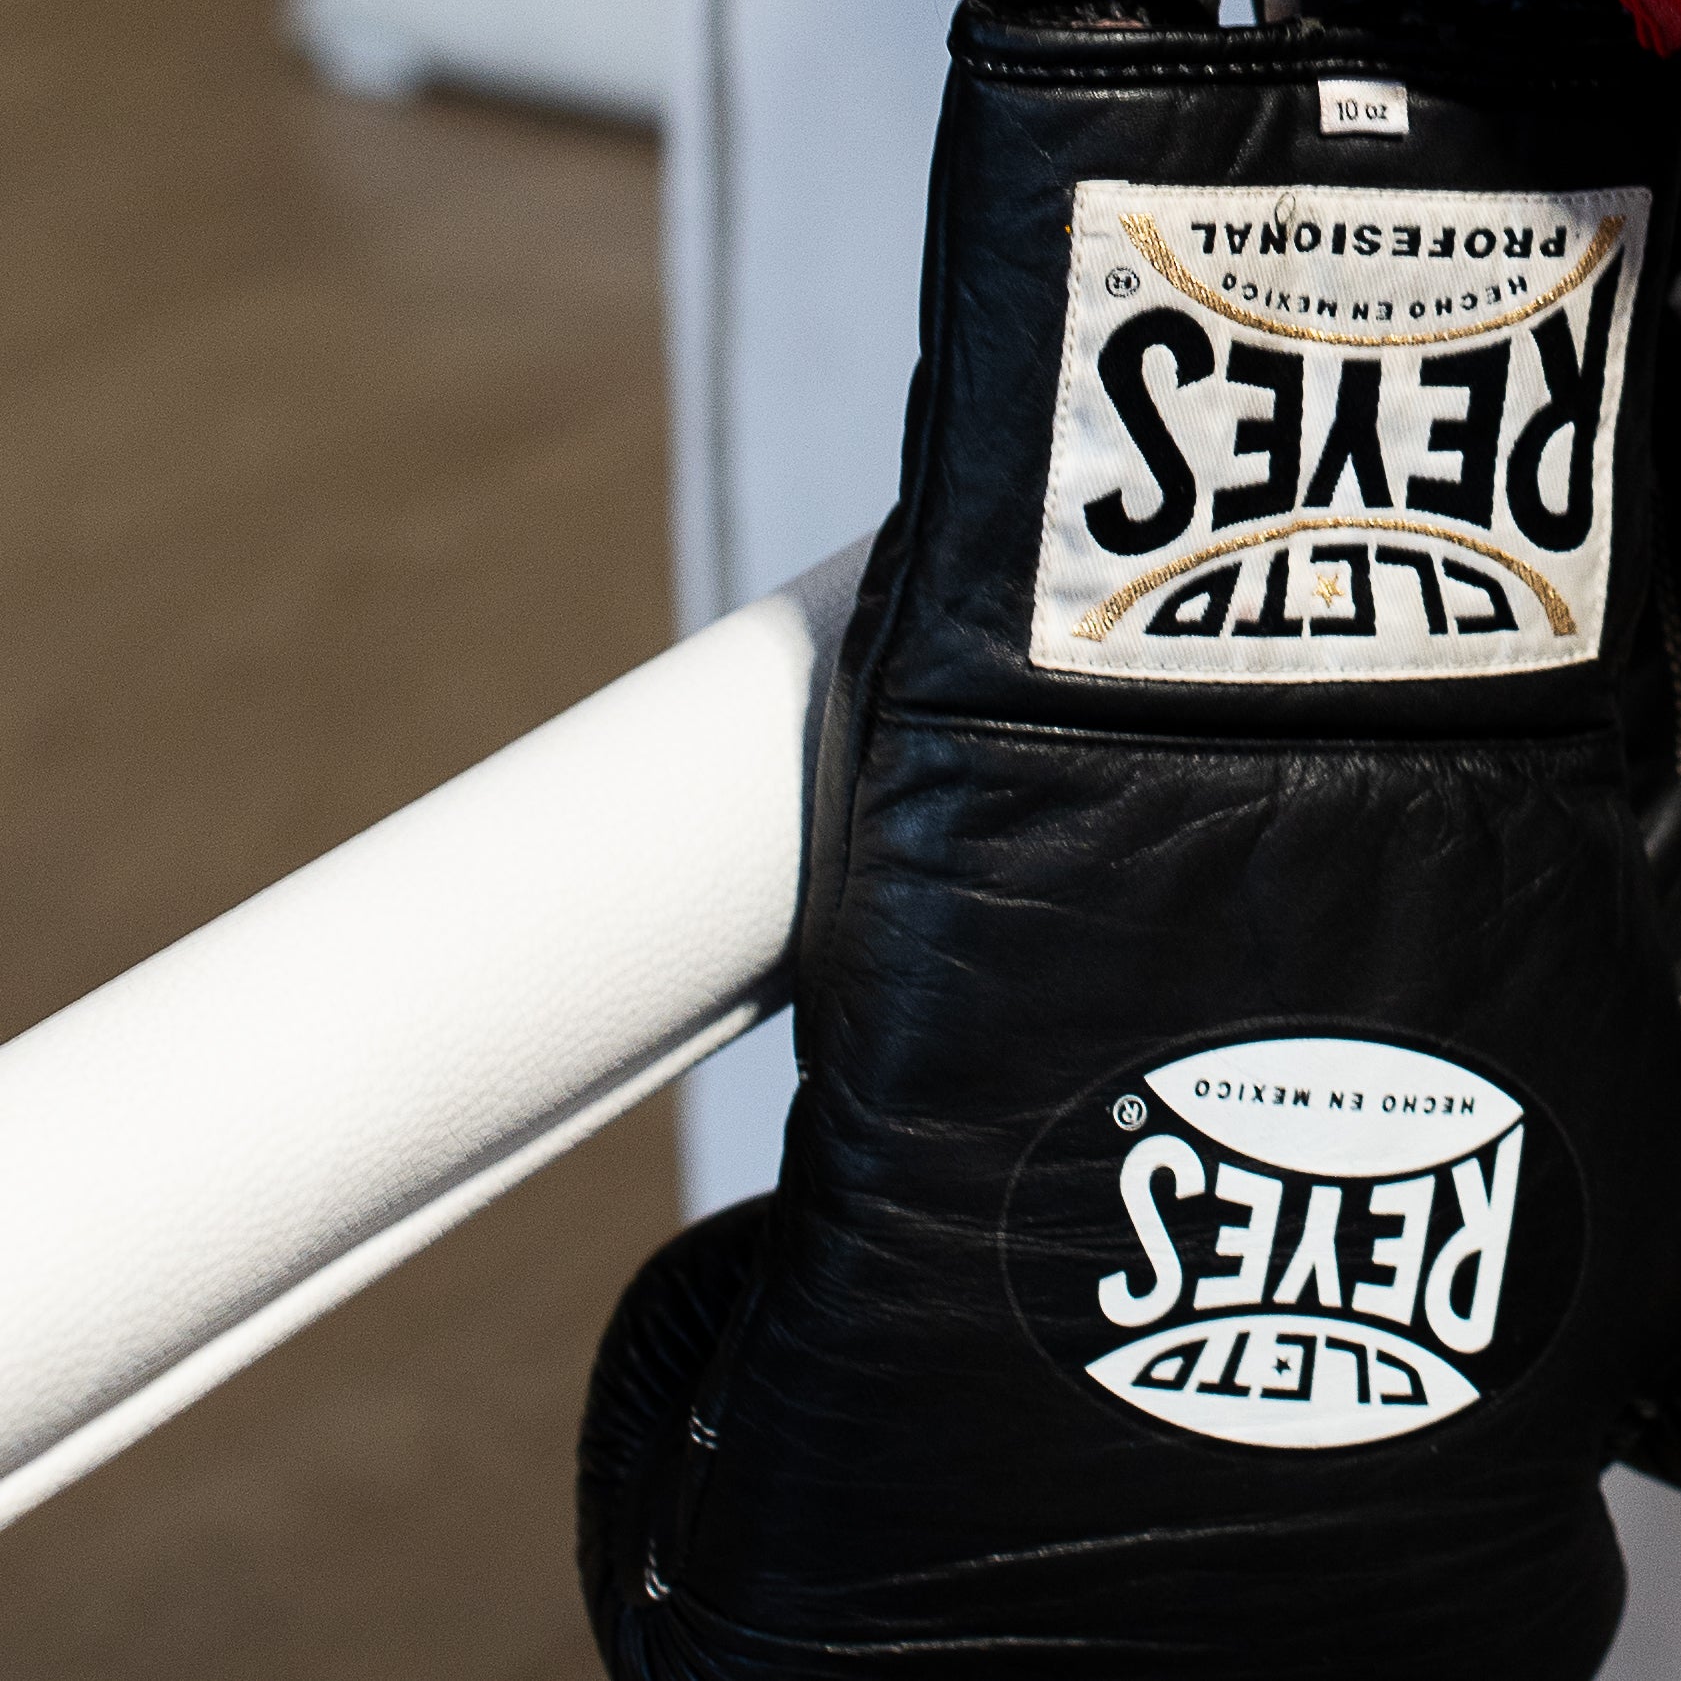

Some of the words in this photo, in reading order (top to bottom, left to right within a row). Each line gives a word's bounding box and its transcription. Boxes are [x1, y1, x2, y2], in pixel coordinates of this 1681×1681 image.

[1335, 98, 1359, 122] 10
[1189, 219, 1568, 258] PROFESIONAL
[1222, 273, 1338, 320] MEXICO
[1352, 299, 1392, 320] EN
[1409, 274, 1527, 320] HECHO
[1083, 249, 1623, 559] REYES
[1144, 542, 1518, 640] CLETO
[1194, 1078, 1311, 1107] MEXICO
[1329, 1090, 1363, 1112] EN
[1381, 1091, 1476, 1117] HECHO
[1097, 1122, 1525, 1355] REYES
[1130, 1331, 1428, 1406] CLETO
